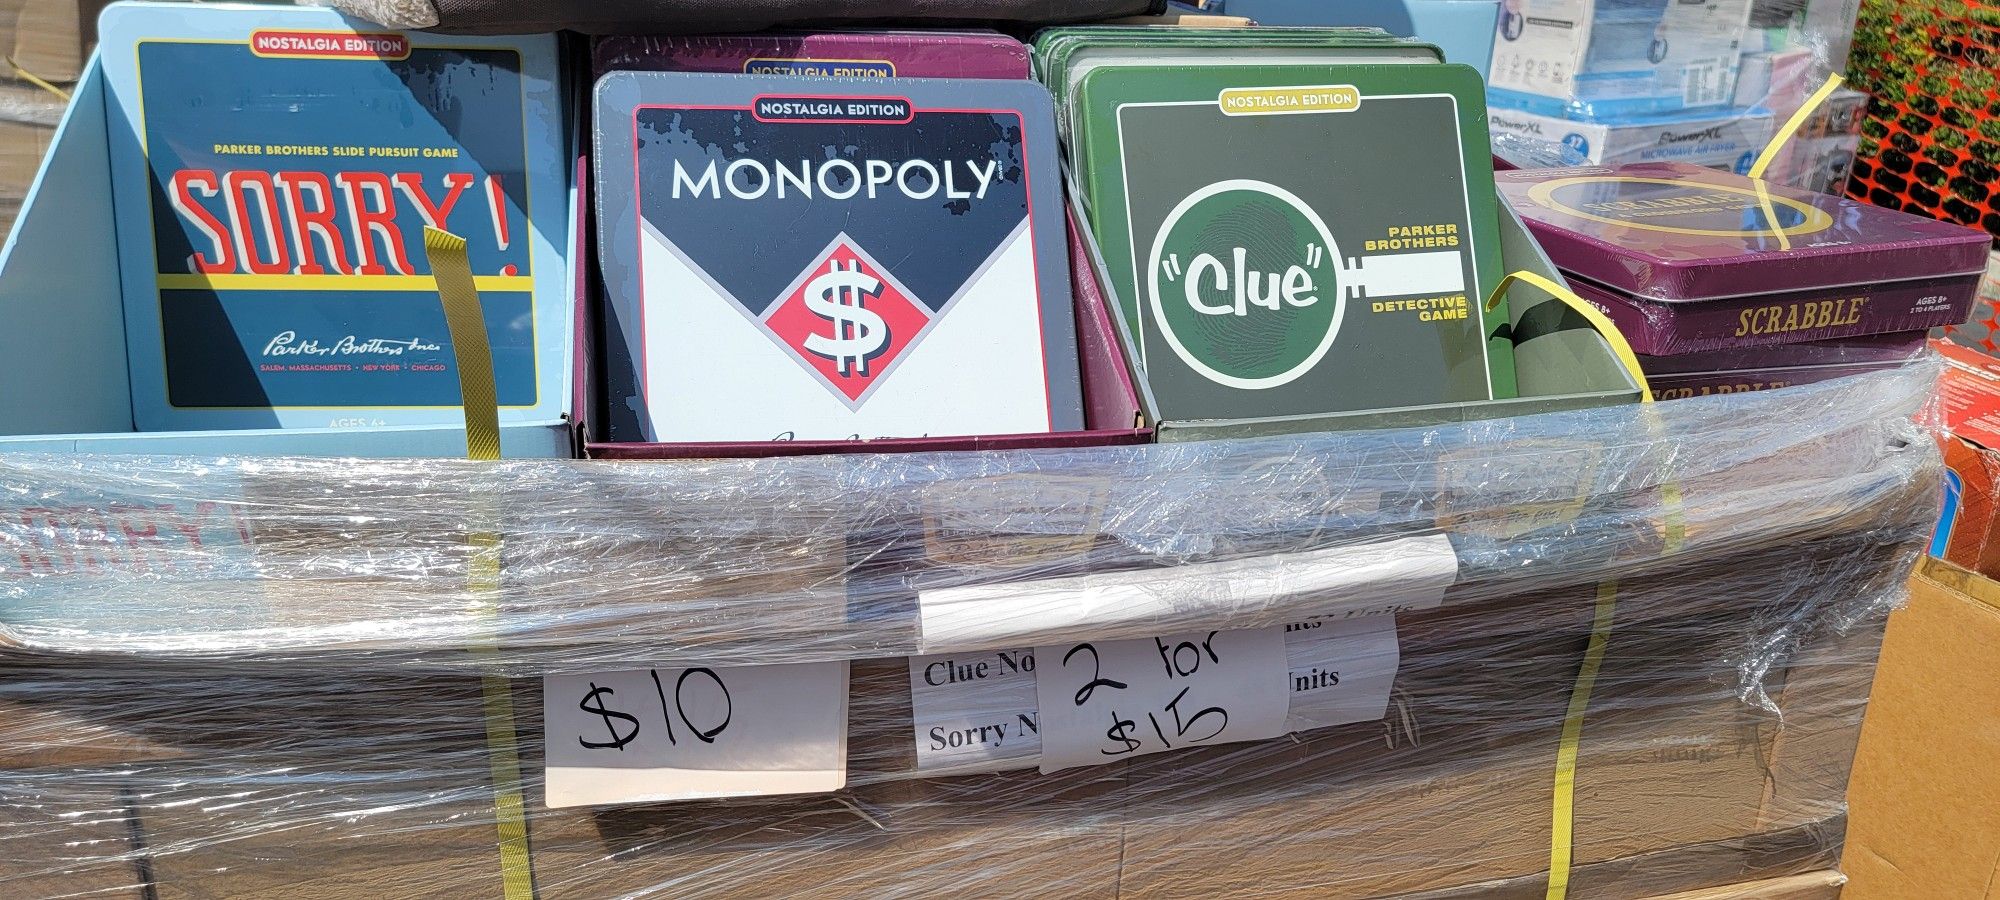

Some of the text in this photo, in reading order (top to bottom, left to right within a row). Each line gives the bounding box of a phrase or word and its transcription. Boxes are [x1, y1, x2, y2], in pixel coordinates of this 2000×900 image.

[258, 37, 402, 52] NOSTALGIA EDITION
[751, 66, 888, 77] NOSTALGIA EDITION
[1227, 93, 1353, 108] NOSTALGIA EDITION
[761, 102, 905, 116] NOSTALGIA EDITION
[213, 144, 459, 158] PARKER BROTHERS SLIDE PURSUIT GAME
[672, 159, 996, 199] MONOPOLY
[1388, 224, 1458, 237] PARKER
[1365, 236, 1459, 251] BROTHERS
[1372, 296, 1467, 313] DETECTIVE
[1916, 296, 1937, 306] AGES
[1420, 308, 1468, 322] GAME
[1735, 297, 1864, 337] SCRABBLE
[262, 330, 330, 357] Parker
[331, 335, 406, 356] Brothers
[288, 363, 352, 372] MASSACHUSETTS
[363, 363, 380, 371] NEW
[381, 363, 400, 371] YORK
[411, 363, 446, 371] CHICAGO
[329, 418, 366, 428] AGES
[924, 660, 989, 686] Clue
[1063, 643, 1128, 706] 2
[1288, 668, 1339, 692] nits
[578, 667, 732, 752] $10
[1101, 686, 1228, 755] $15
[929, 722, 1008, 751] Sorry
